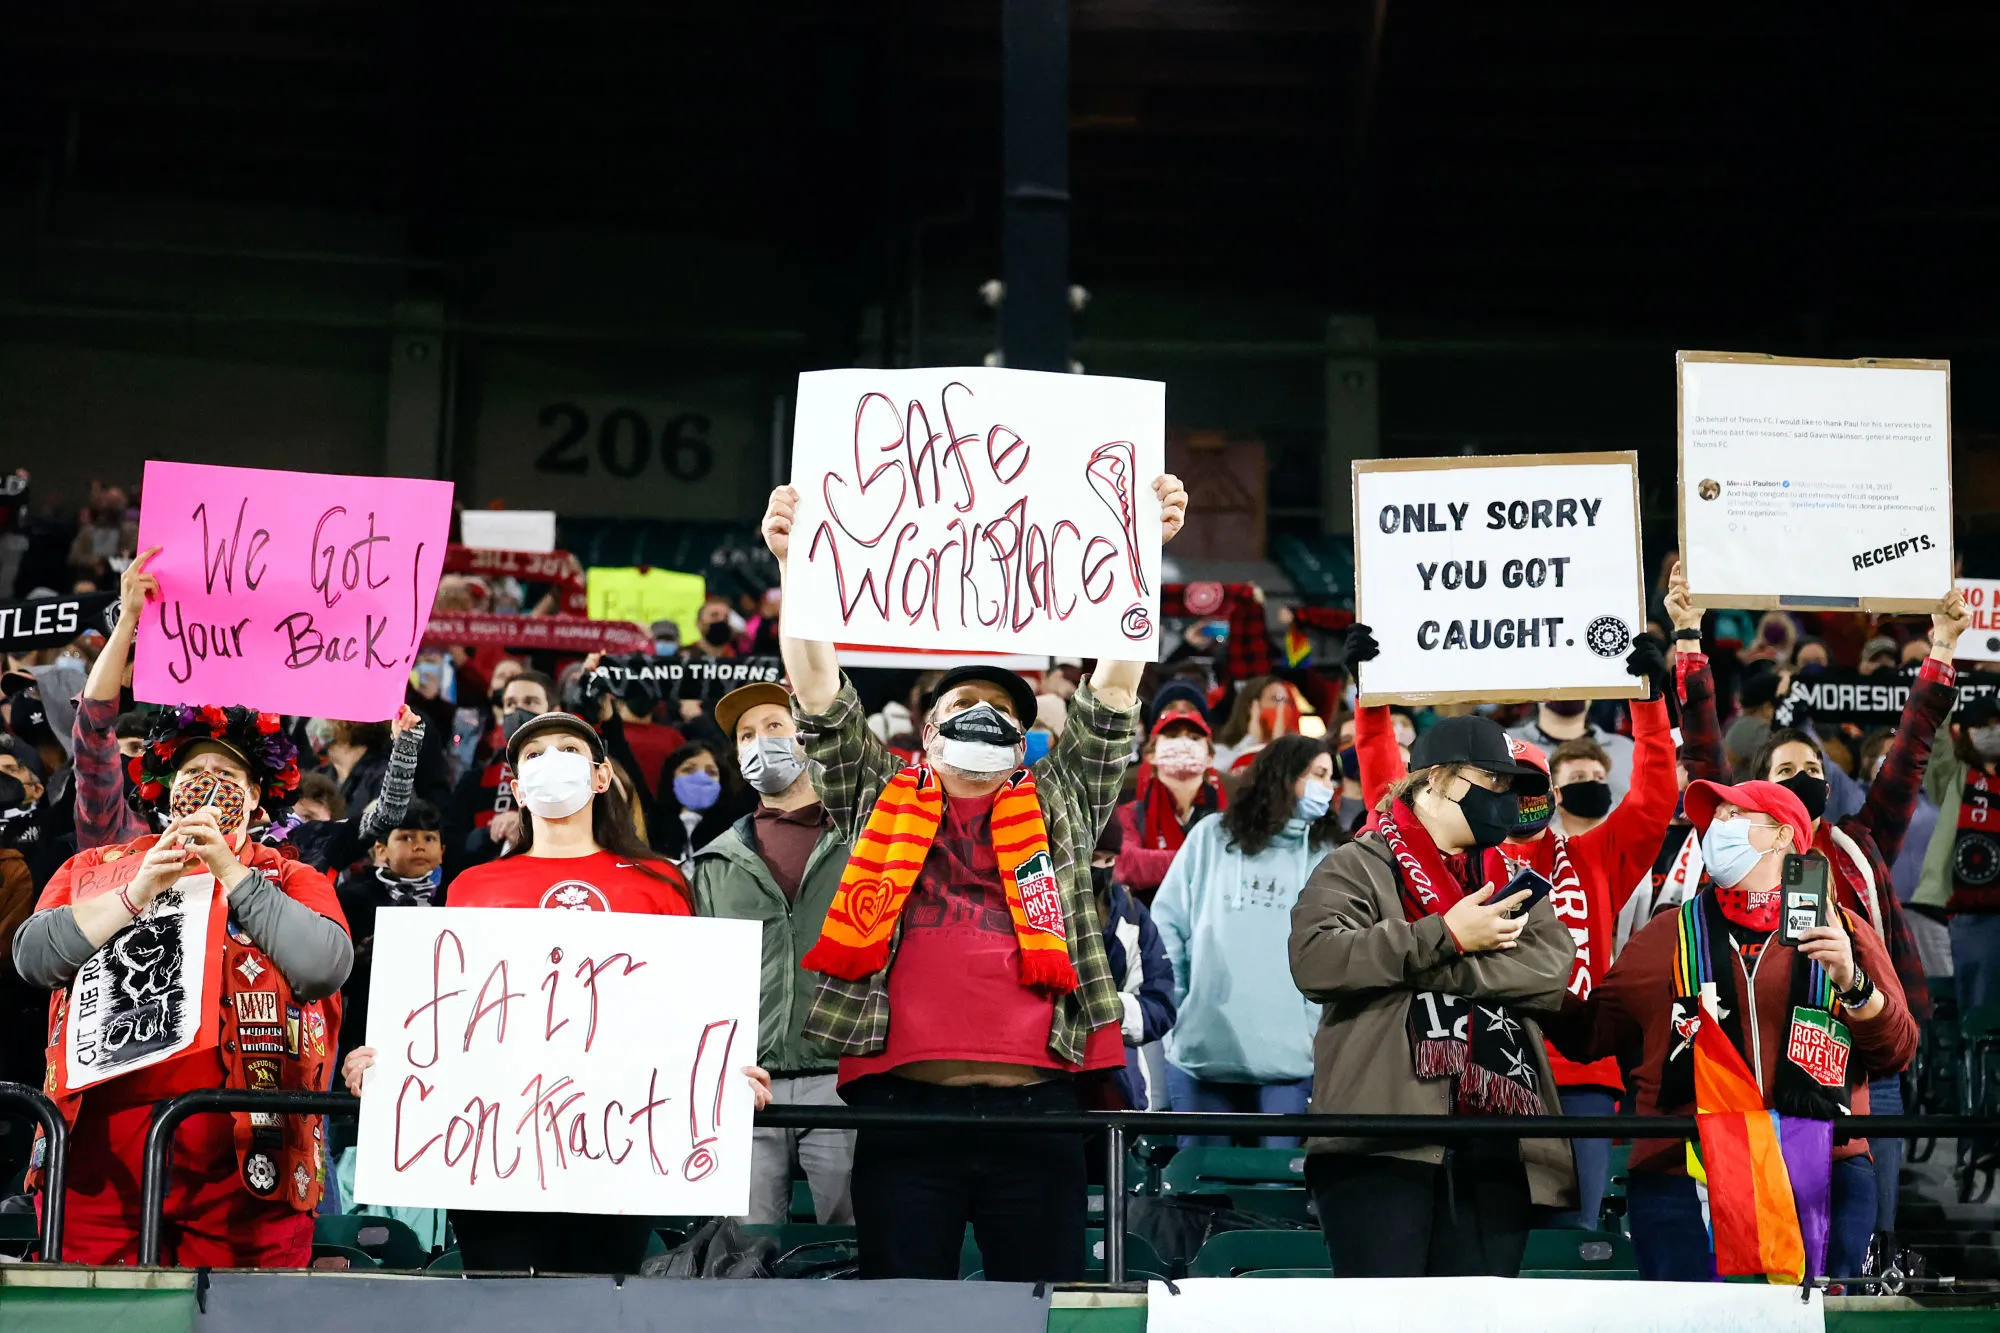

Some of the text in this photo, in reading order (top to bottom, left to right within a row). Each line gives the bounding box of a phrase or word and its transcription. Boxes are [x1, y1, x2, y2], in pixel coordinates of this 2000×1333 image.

[1779, 417, 1800, 425] would
[1802, 417, 1814, 425] like
[1823, 419, 1842, 427] thank
[1884, 421, 1912, 429] services
[1794, 430, 1809, 438] said
[1809, 431, 1828, 439] Gavin
[535, 403, 713, 482] 206
[1379, 497, 1603, 534] ONLY SORRY
[192, 498, 390, 608] We Got
[1852, 535, 1936, 571] RECEIPTS.
[1416, 557, 1571, 590] YOU GOT
[1417, 617, 1575, 650] CAUGHT.
[1022, 878, 1050, 898] ROSE
[1750, 892, 1770, 904] ROSE
[79, 987, 99, 1021] THE
[239, 993, 275, 1020] MVP
[78, 1028, 97, 1066] CUT
[1794, 1024, 1827, 1048] ROSE
